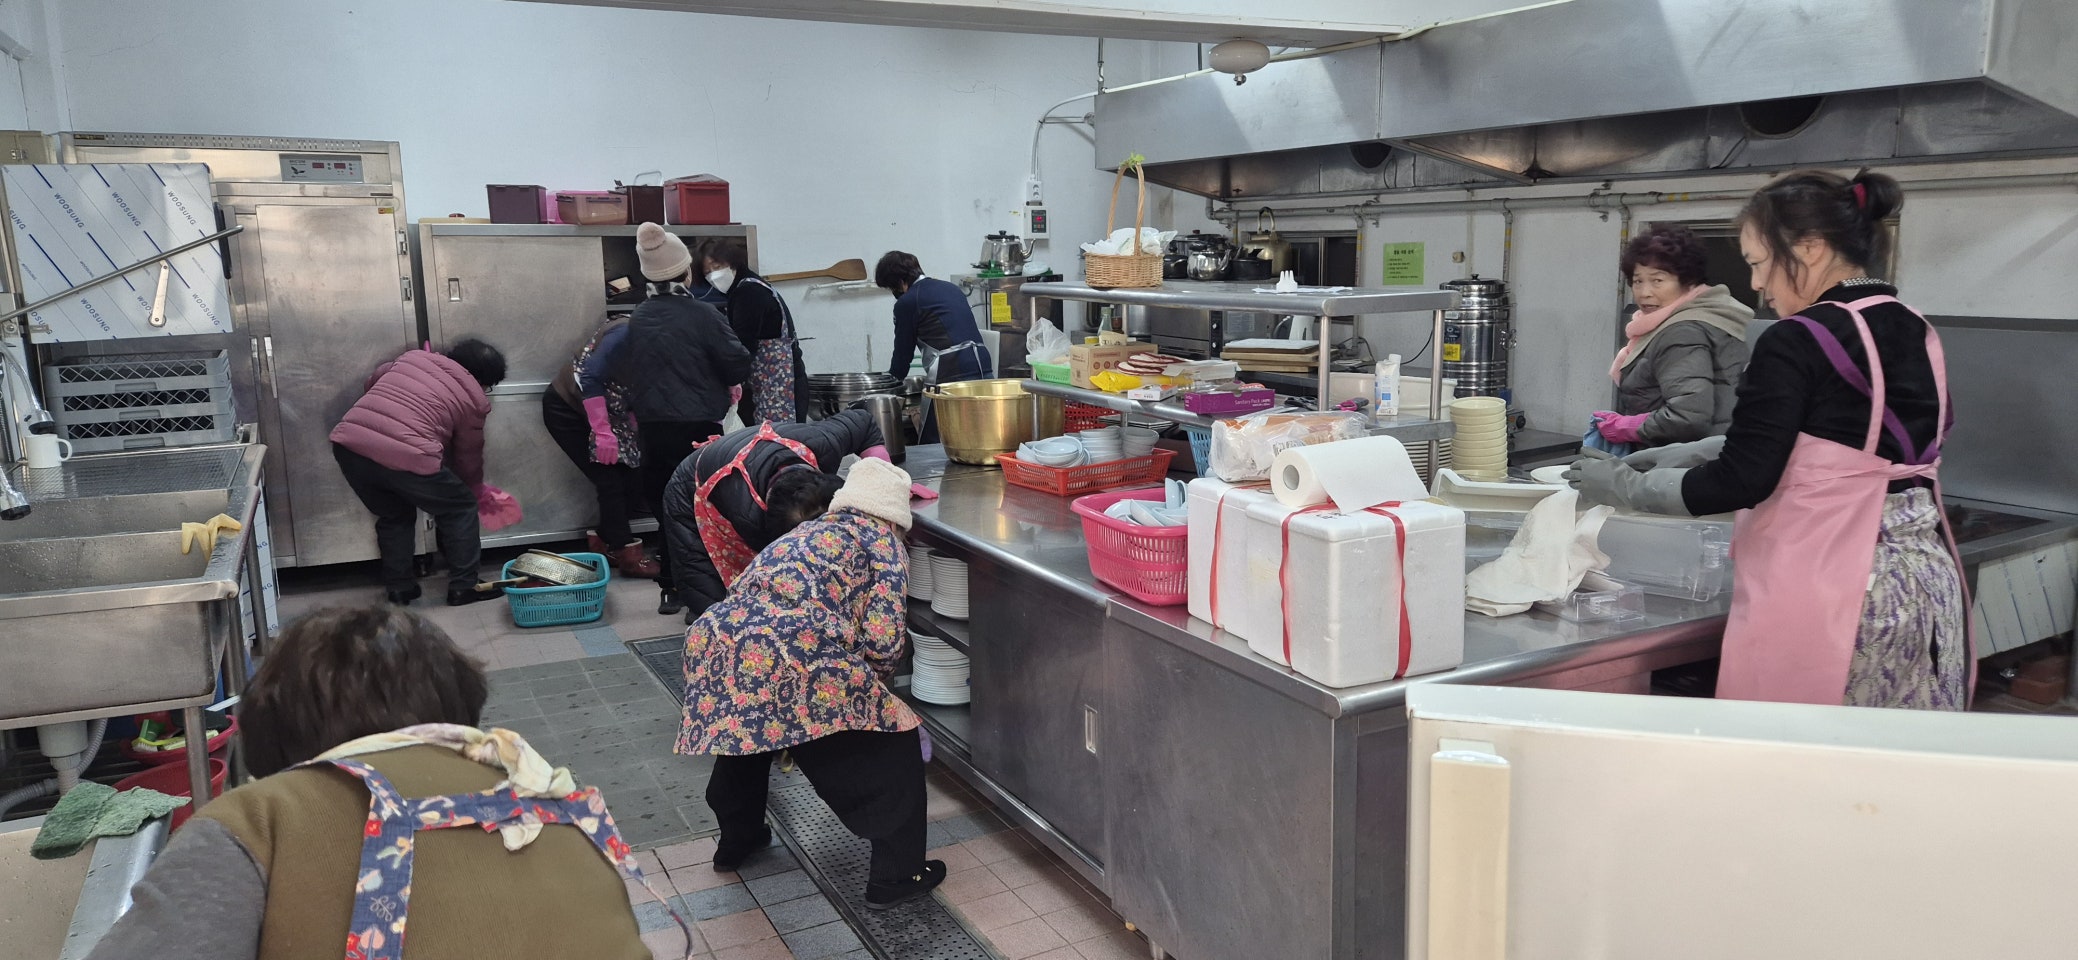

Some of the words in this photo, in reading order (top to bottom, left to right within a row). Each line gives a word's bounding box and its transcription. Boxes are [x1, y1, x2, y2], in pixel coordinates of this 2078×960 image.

[54, 192, 85, 228] WOOSUNG
[111, 191, 141, 227] WOOSUNG
[167, 190, 197, 226] WOOSUNG
[80, 298, 111, 332] WOOSUNG
[192, 293, 220, 326] WOOSUNG
